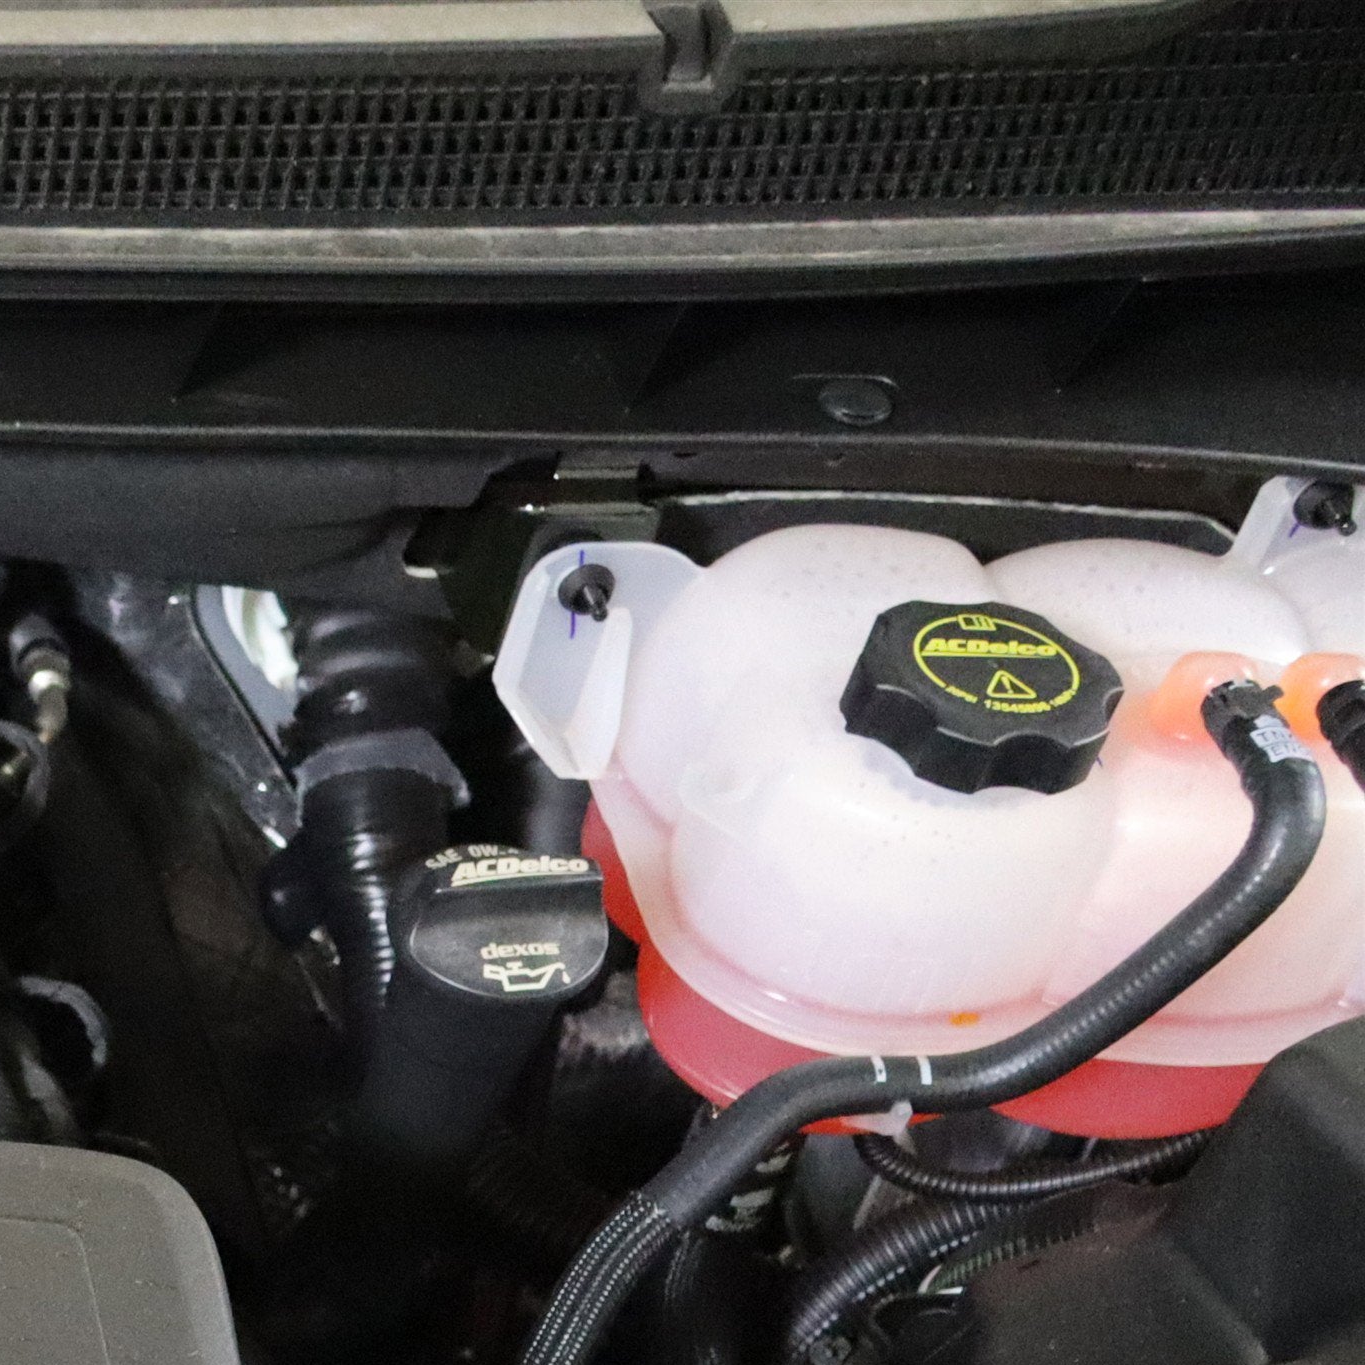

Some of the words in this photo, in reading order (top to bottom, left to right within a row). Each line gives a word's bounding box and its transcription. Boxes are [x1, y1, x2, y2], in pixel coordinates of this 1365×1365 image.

[923, 638, 1057, 657] ACDelco
[425, 848, 463, 870] SAE
[451, 855, 590, 884] ACDelco
[480, 942, 561, 960] dexos
